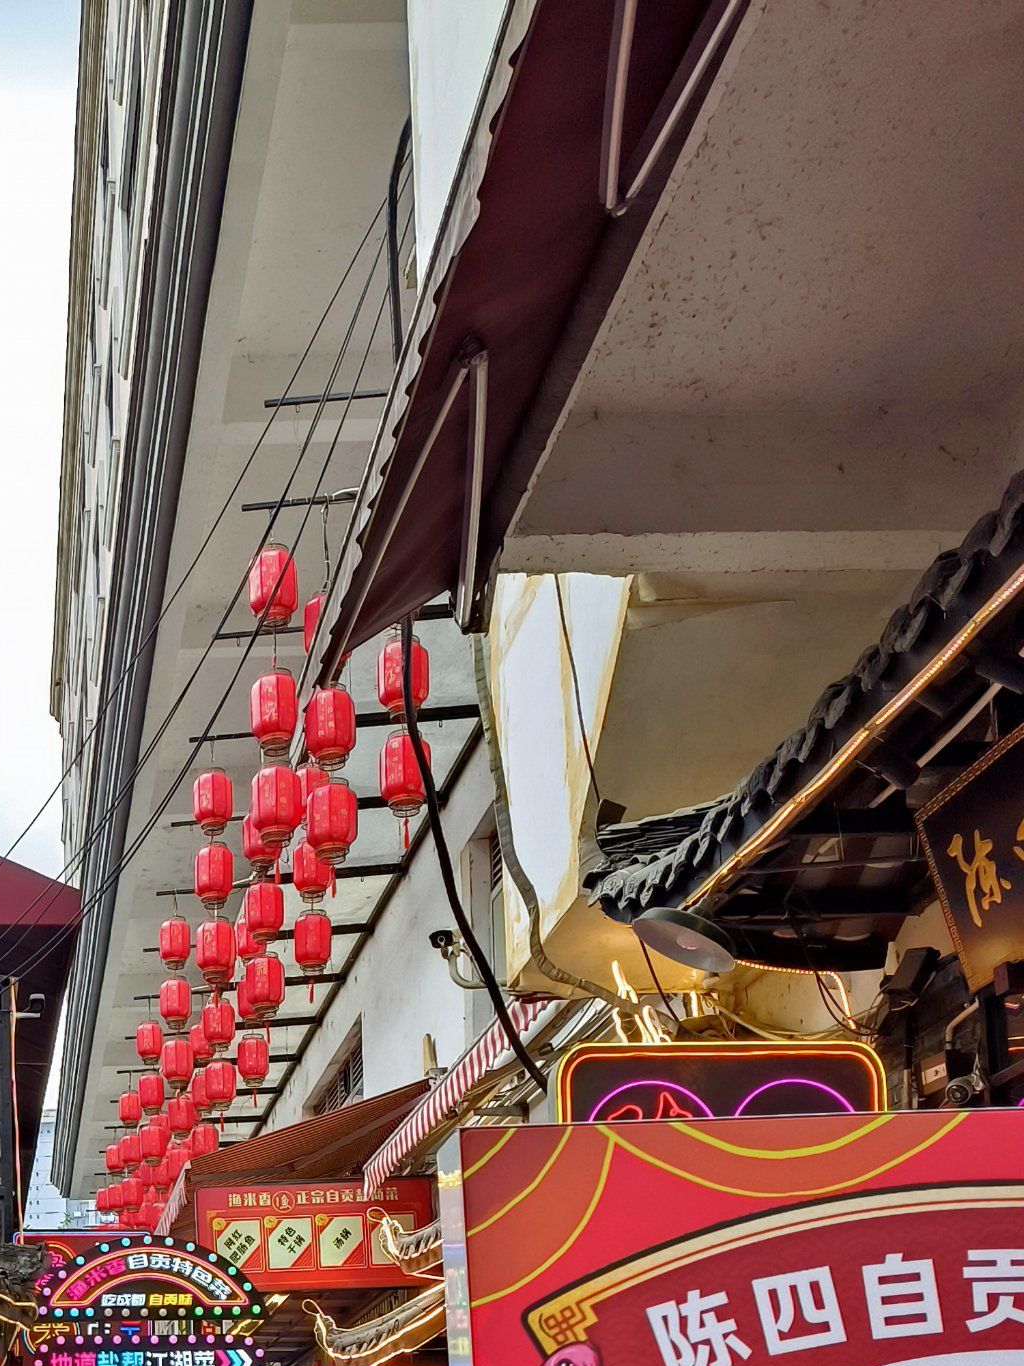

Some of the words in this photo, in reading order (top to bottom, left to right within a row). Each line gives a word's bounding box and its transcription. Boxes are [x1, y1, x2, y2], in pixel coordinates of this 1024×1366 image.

[228, 1192, 271, 1208] 渔米香
[223, 1230, 243, 1250] 网红
[277, 1226, 297, 1247] 特色
[287, 1235, 306, 1254] 干锅
[332, 1228, 352, 1250] 汤锅
[228, 1235, 256, 1265] 肥肠鱼
[101, 1293, 146, 1307] 吃成都
[149, 1293, 194, 1306] 自贡味
